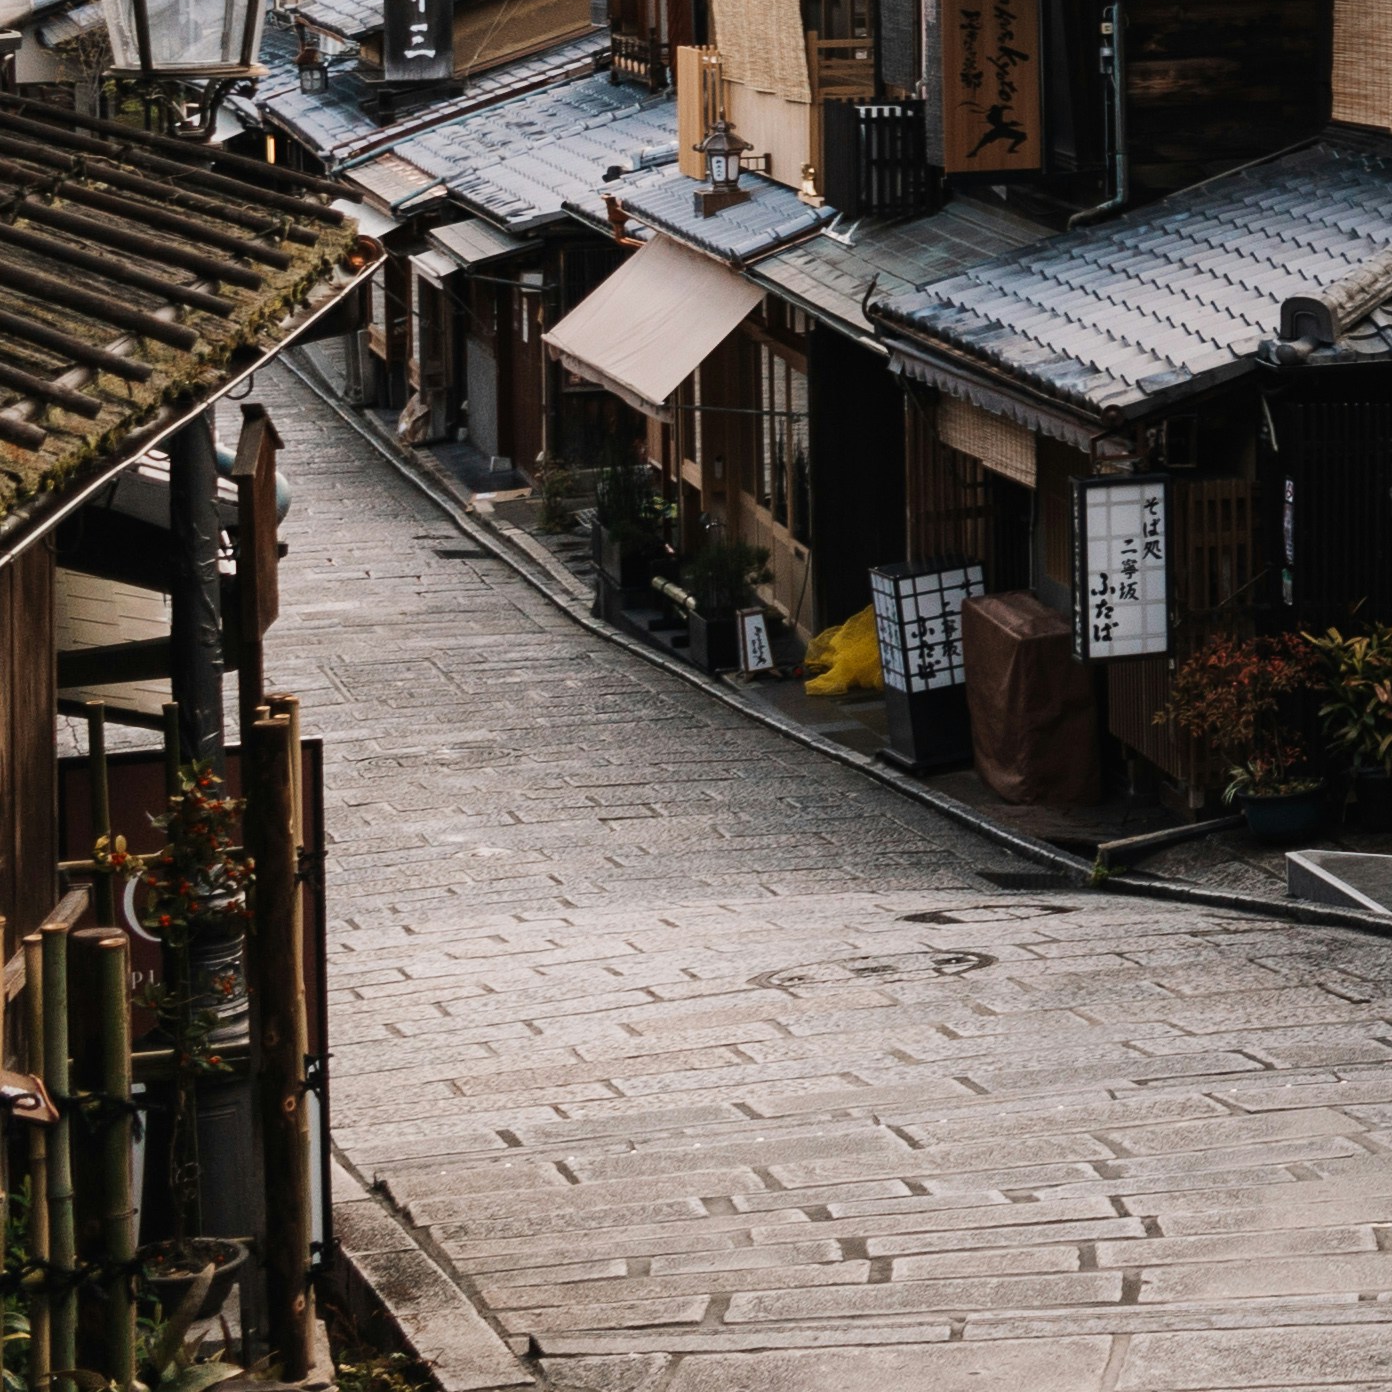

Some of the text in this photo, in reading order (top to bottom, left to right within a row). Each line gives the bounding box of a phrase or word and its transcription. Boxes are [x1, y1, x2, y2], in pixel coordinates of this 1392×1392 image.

[1142, 496, 1163, 560] そば処
[1090, 572, 1119, 643] ふたば
[911, 615, 942, 680] ふたば
